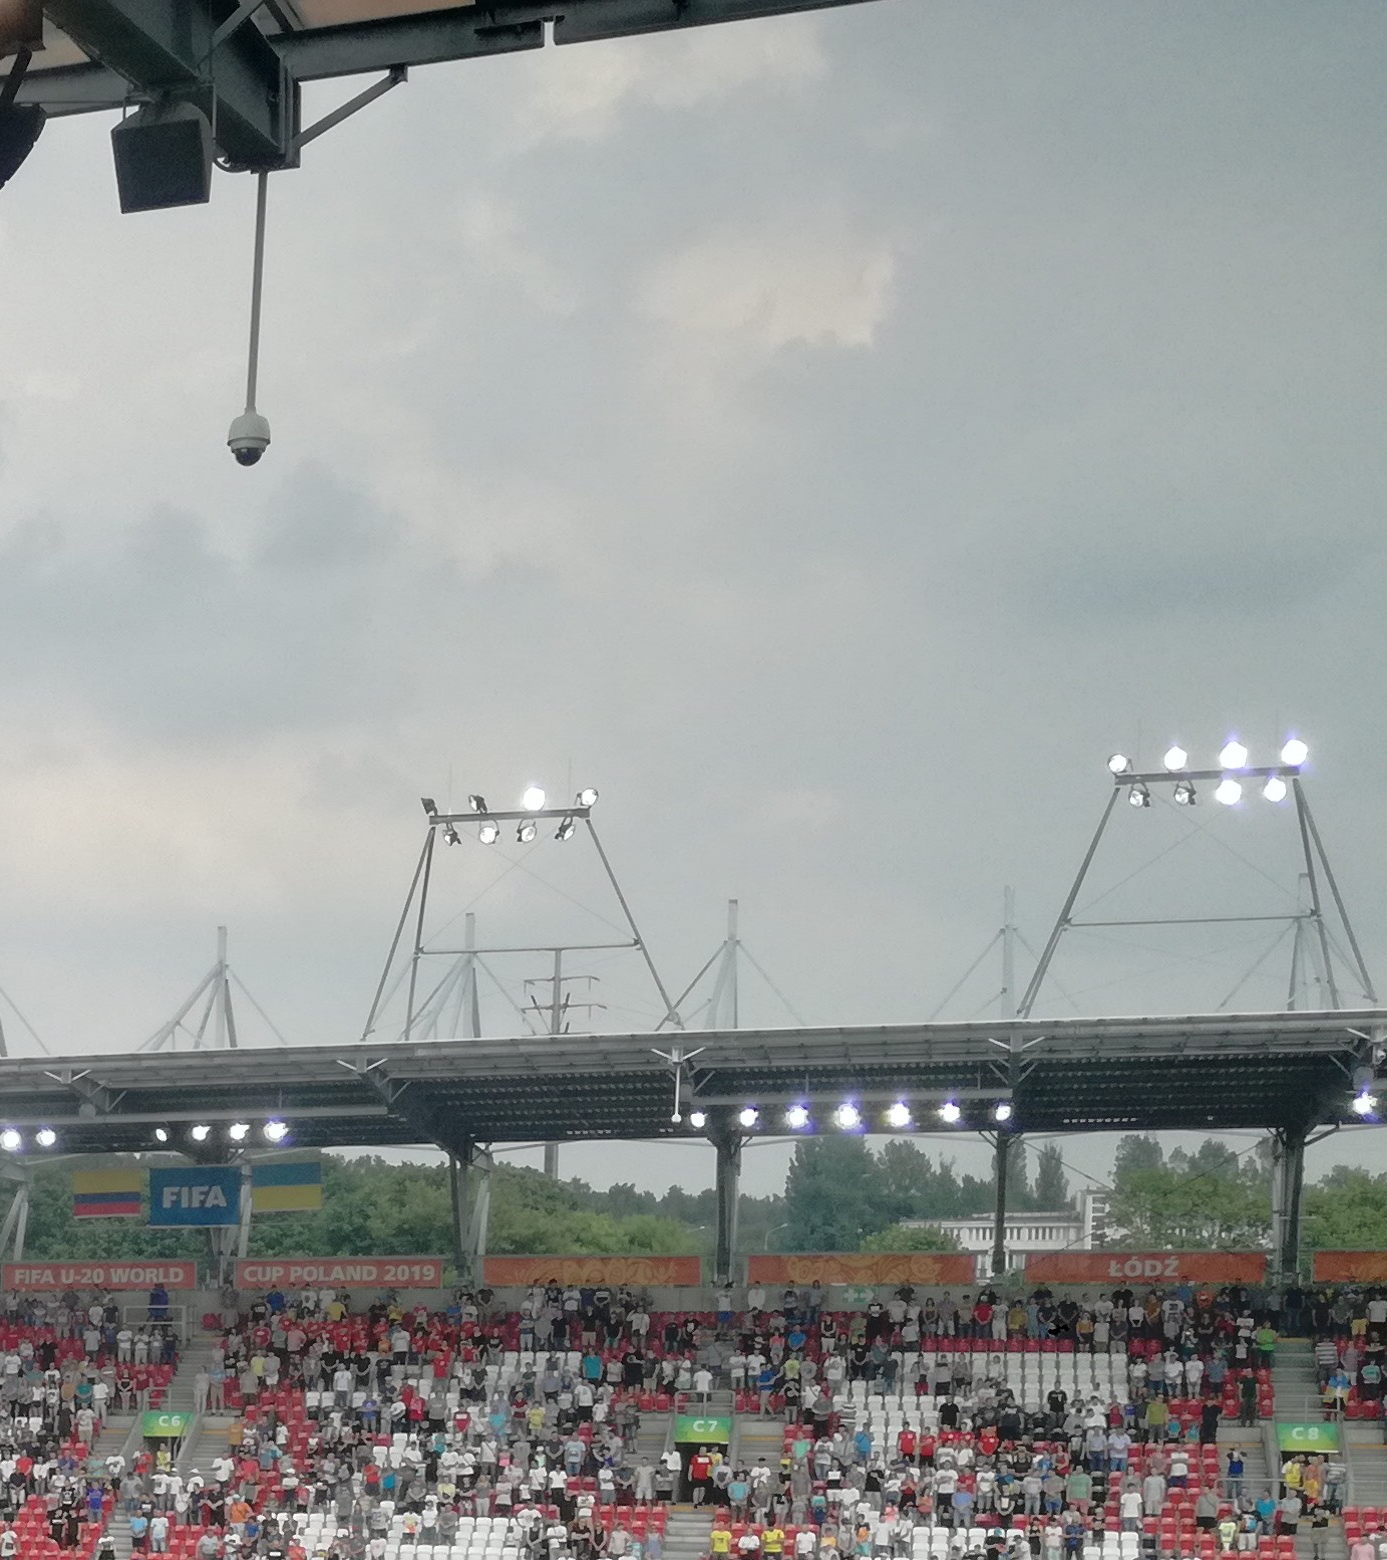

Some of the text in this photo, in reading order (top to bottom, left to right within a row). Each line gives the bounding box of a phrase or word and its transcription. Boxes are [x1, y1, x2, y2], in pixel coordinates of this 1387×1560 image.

[162, 1185, 227, 1209] FIFA
[244, 1264, 435, 1282] CUP POLAND 2019
[1108, 1256, 1180, 1277] ŁÓDŹ
[14, 1267, 184, 1284] FIFA U-20 WORLD
[158, 1416, 181, 1427] C6
[692, 1420, 718, 1432] C7
[1291, 1427, 1319, 1440] C8
